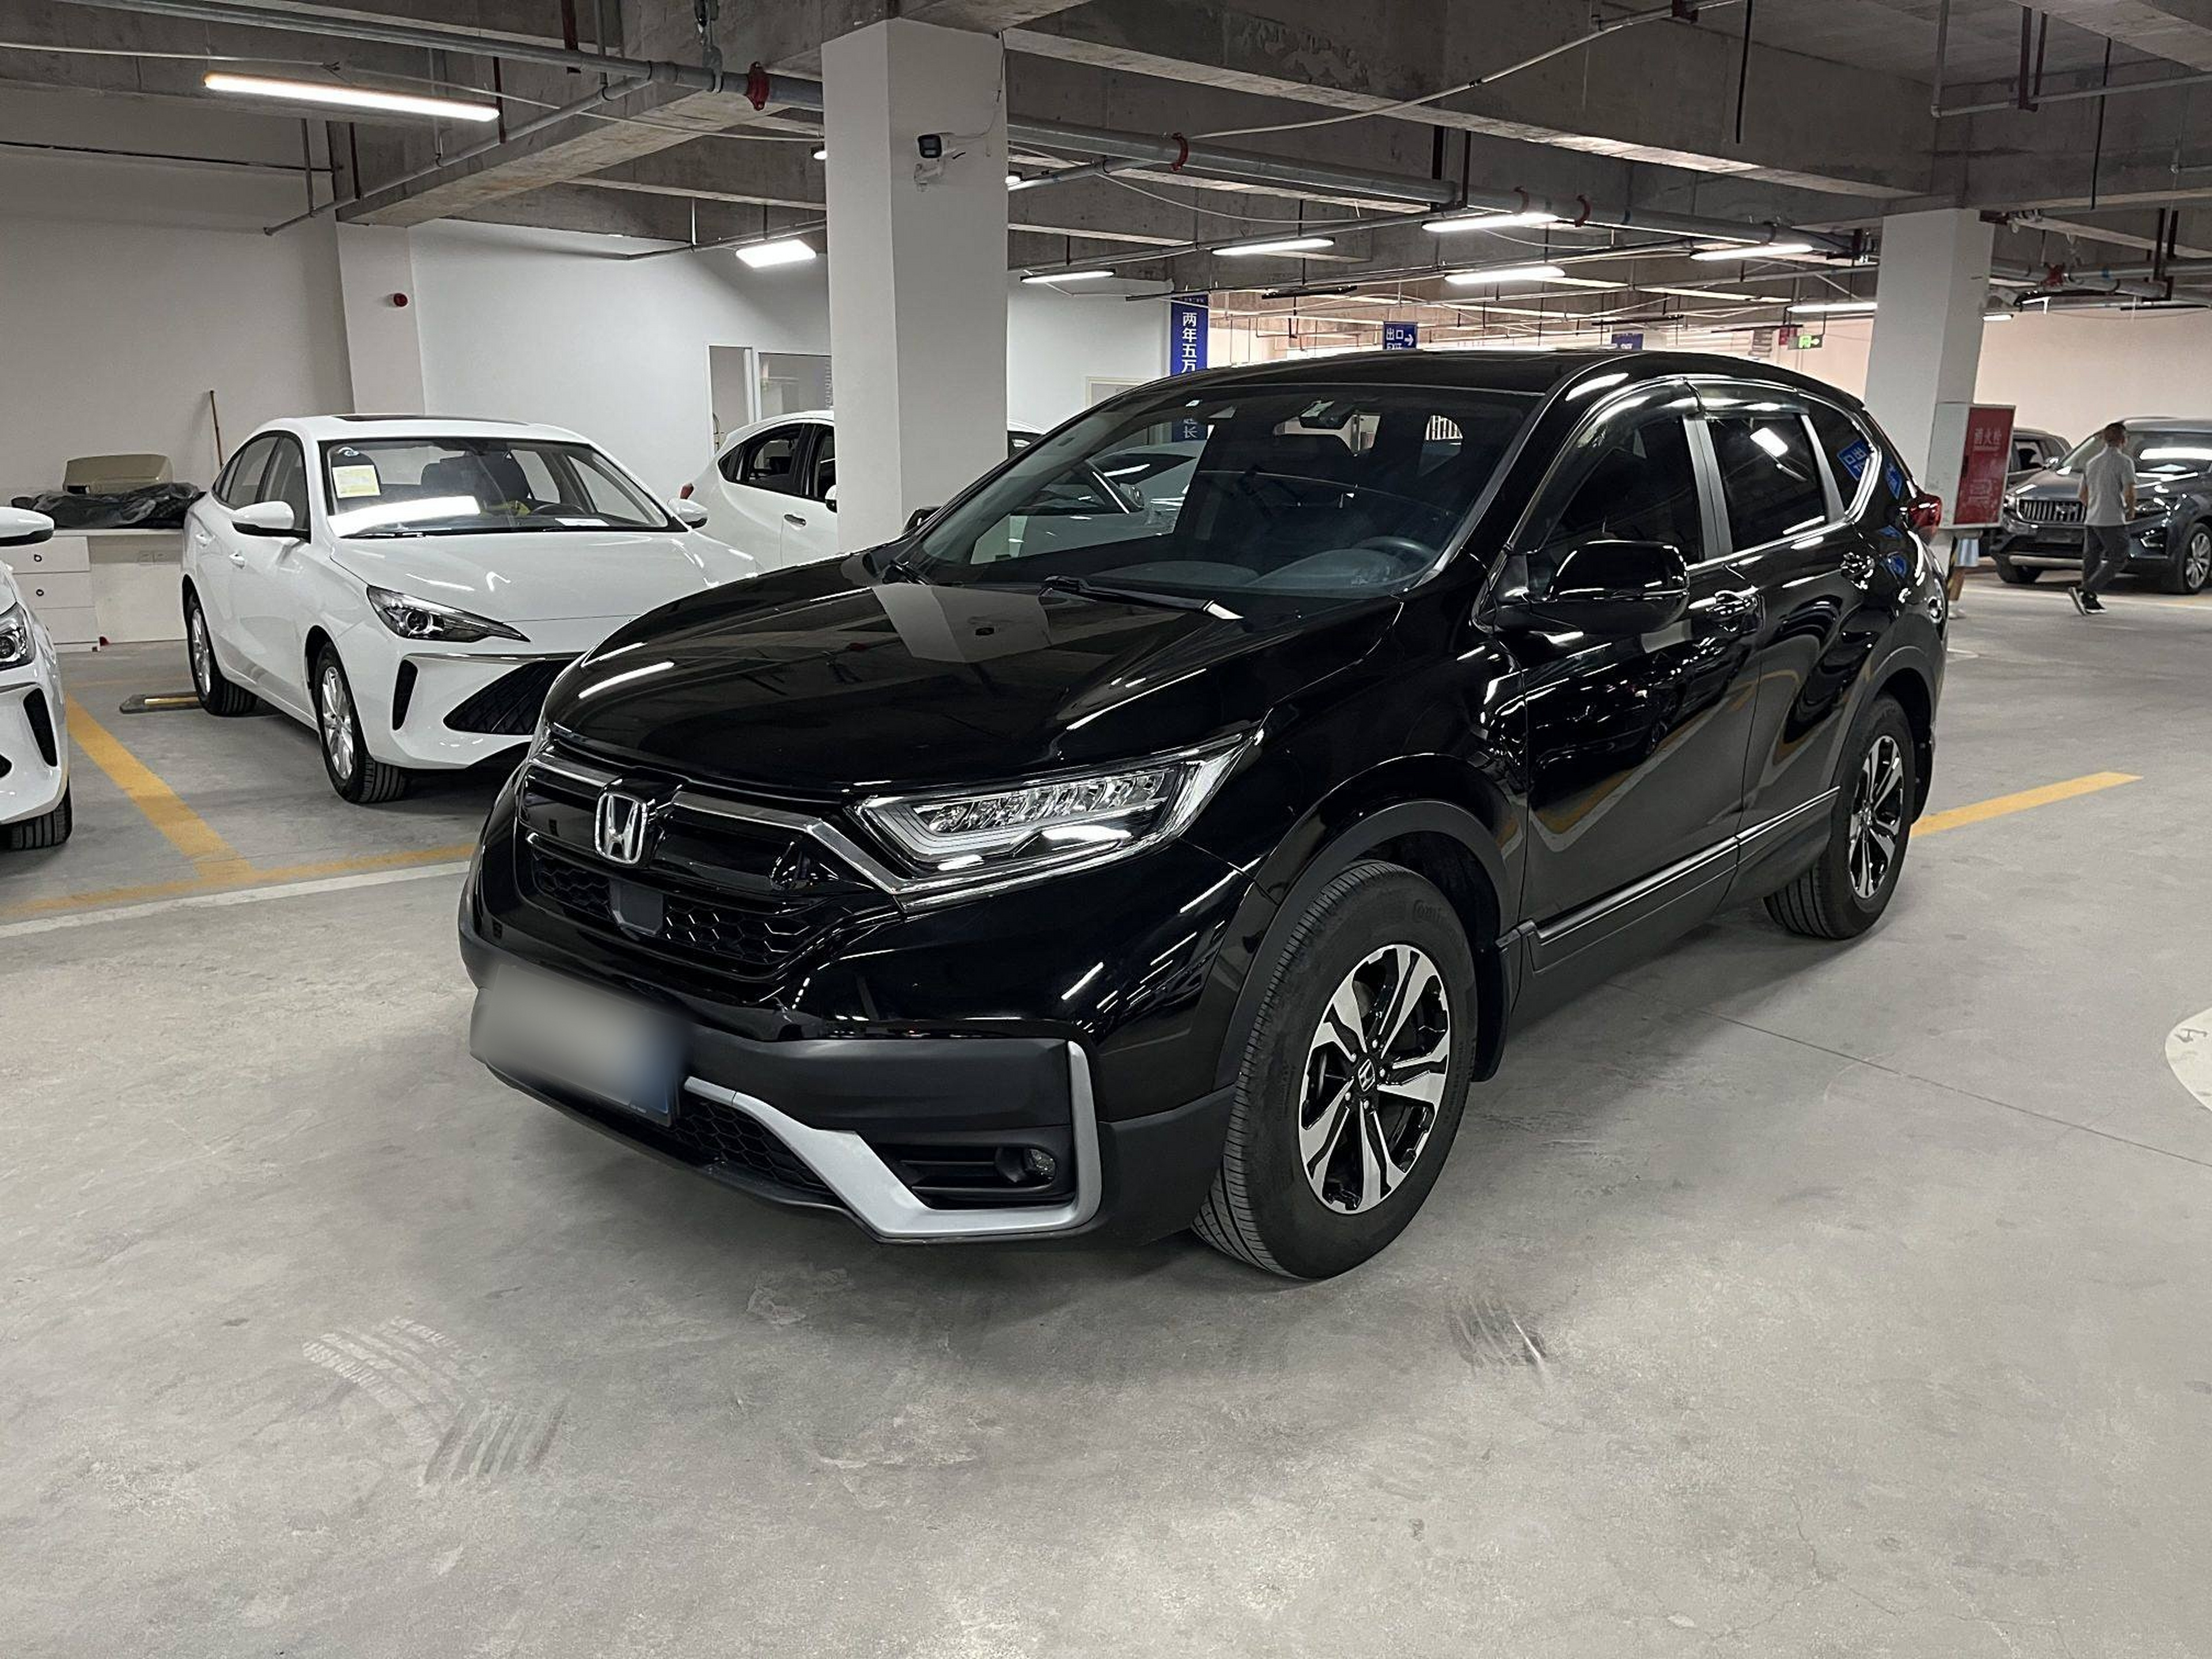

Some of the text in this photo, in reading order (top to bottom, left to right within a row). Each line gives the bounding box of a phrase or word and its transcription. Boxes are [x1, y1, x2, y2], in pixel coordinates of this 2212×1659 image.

[1181, 312, 1197, 373] 两年五万
[1386, 328, 1404, 340] 出口
